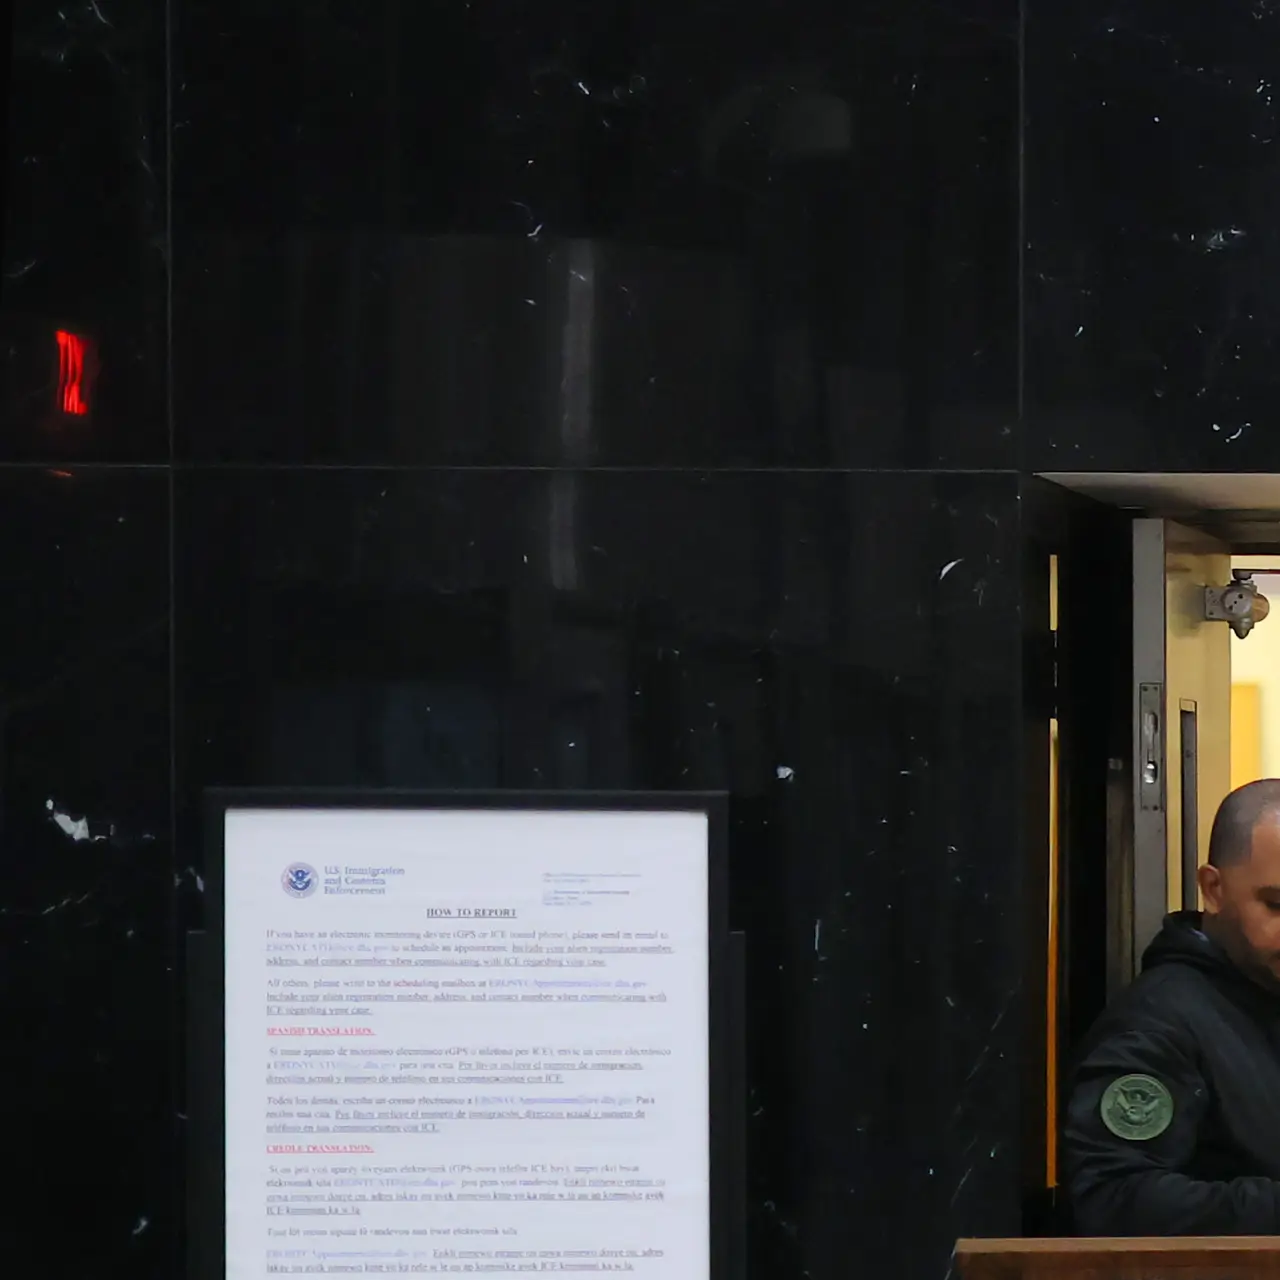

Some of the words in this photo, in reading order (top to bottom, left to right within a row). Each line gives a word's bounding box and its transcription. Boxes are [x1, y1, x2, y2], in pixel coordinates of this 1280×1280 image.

[426, 908, 451, 918] HOW
[457, 908, 471, 918] TO
[474, 908, 517, 918] REPORT
